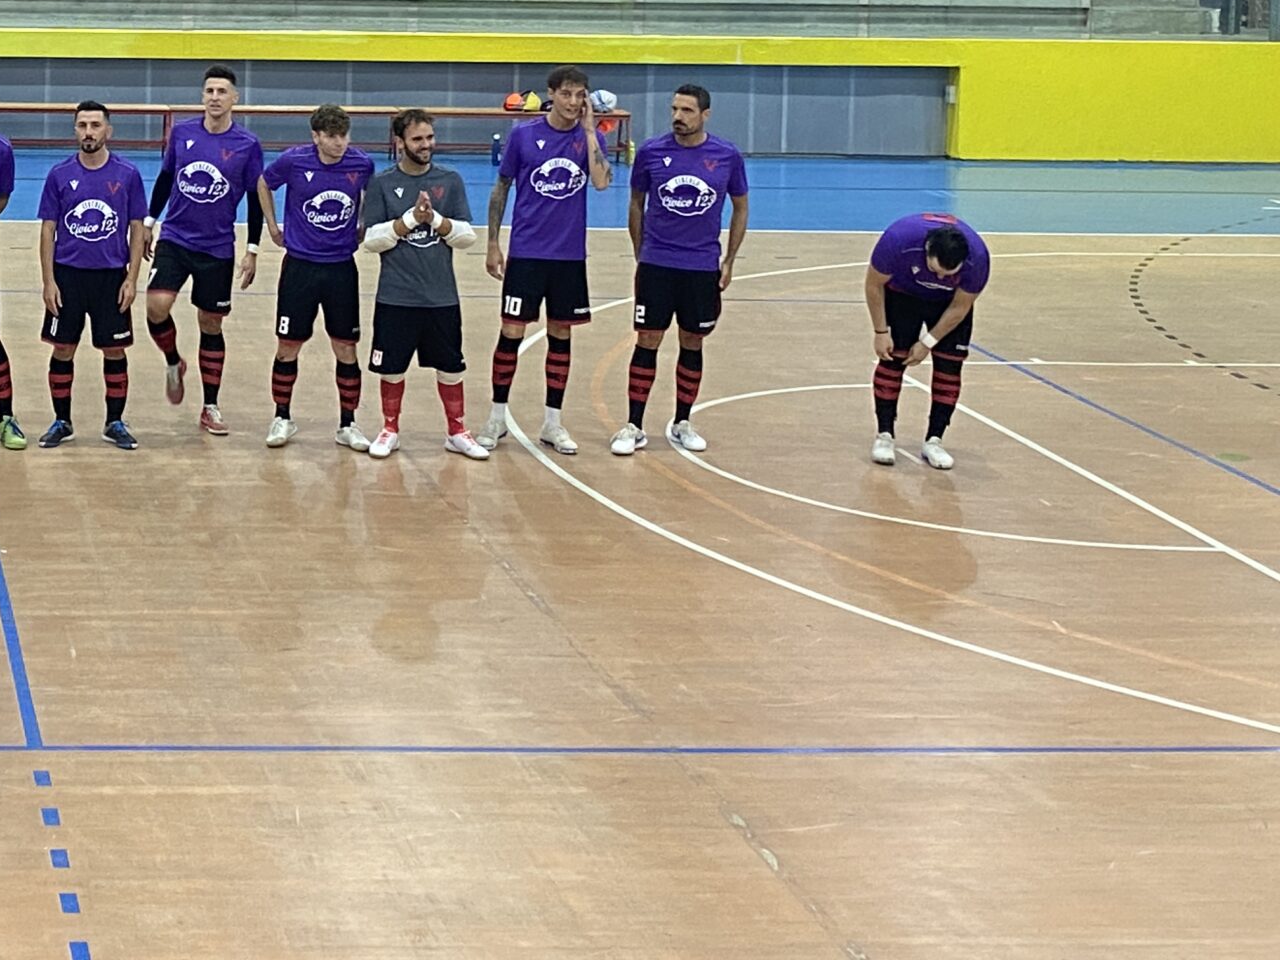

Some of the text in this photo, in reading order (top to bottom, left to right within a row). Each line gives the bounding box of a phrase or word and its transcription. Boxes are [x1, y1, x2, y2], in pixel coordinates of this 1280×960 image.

[307, 211, 338, 223] Civico
[70, 222, 99, 235] Civico
[504, 295, 523, 316] 10
[635, 304, 646, 324] 2
[278, 315, 290, 335] 8
